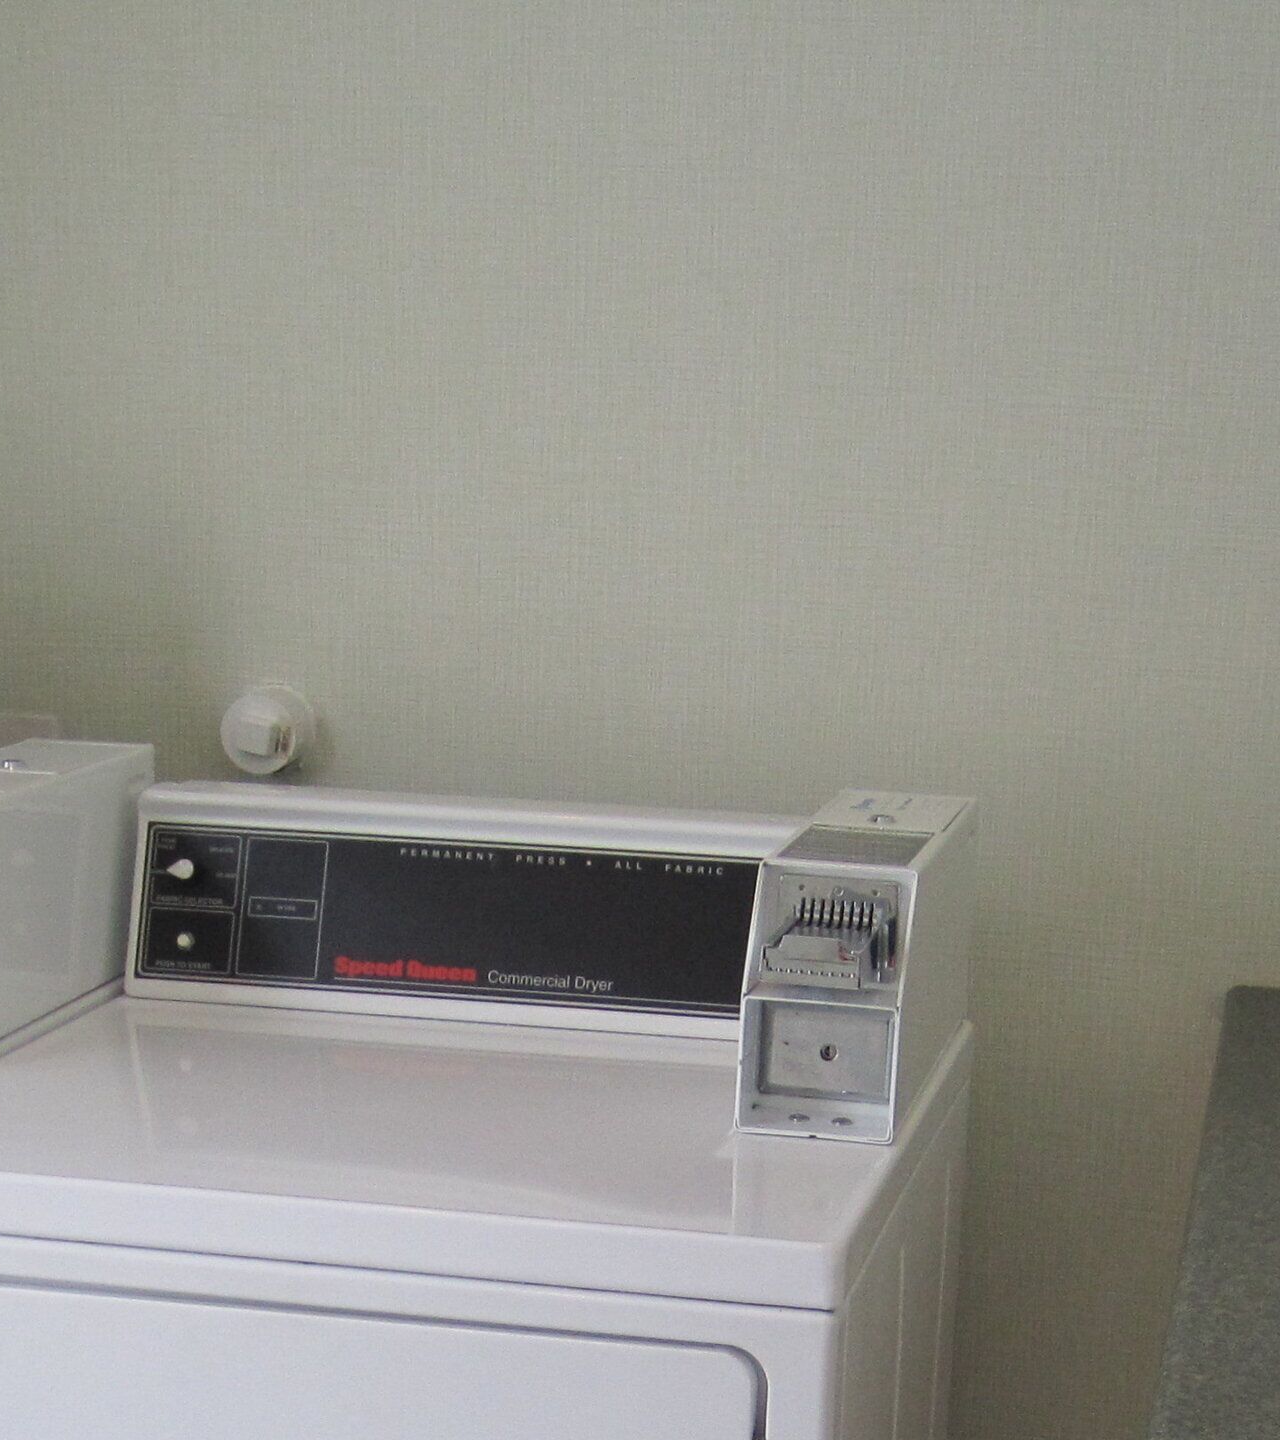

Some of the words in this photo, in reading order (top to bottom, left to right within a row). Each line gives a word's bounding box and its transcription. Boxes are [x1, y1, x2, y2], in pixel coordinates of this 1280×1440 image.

[400, 848, 495, 861] PERMANENT
[516, 854, 567, 866] PRESS
[614, 860, 643, 871] ALL
[665, 863, 724, 876] FABRIC
[334, 956, 404, 977] Speed
[407, 960, 477, 982] Queen
[487, 969, 570, 989] Commercial
[574, 976, 614, 993] Dryer
